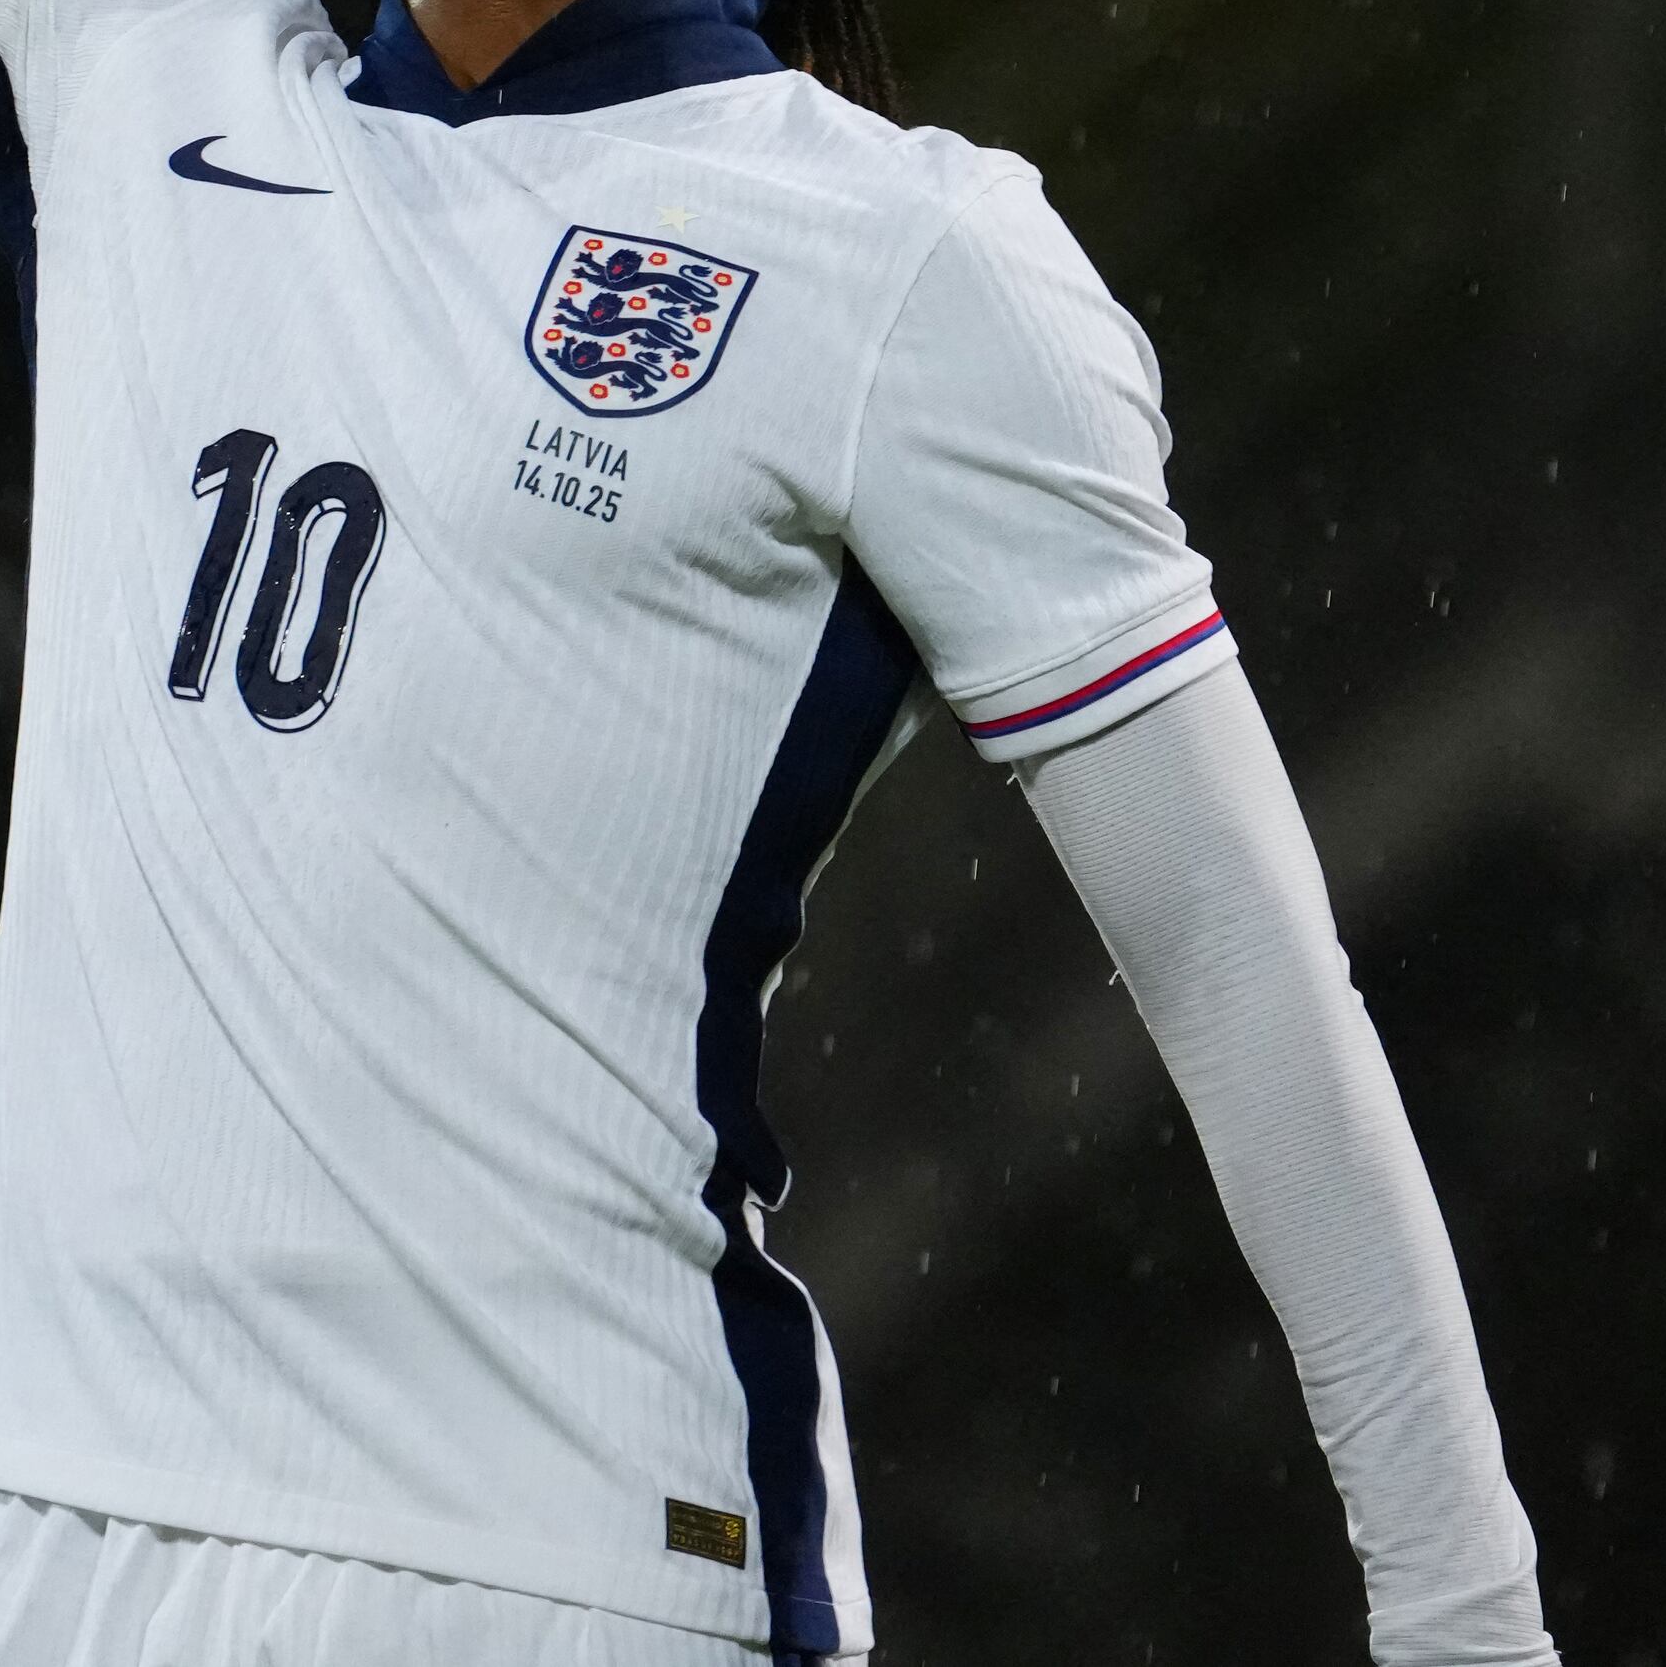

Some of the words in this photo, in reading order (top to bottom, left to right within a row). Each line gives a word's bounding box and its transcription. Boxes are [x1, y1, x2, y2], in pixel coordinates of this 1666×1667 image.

[525, 419, 630, 483] LATVIA
[513, 458, 623, 525] 14.10.25
[167, 428, 388, 734] 10
